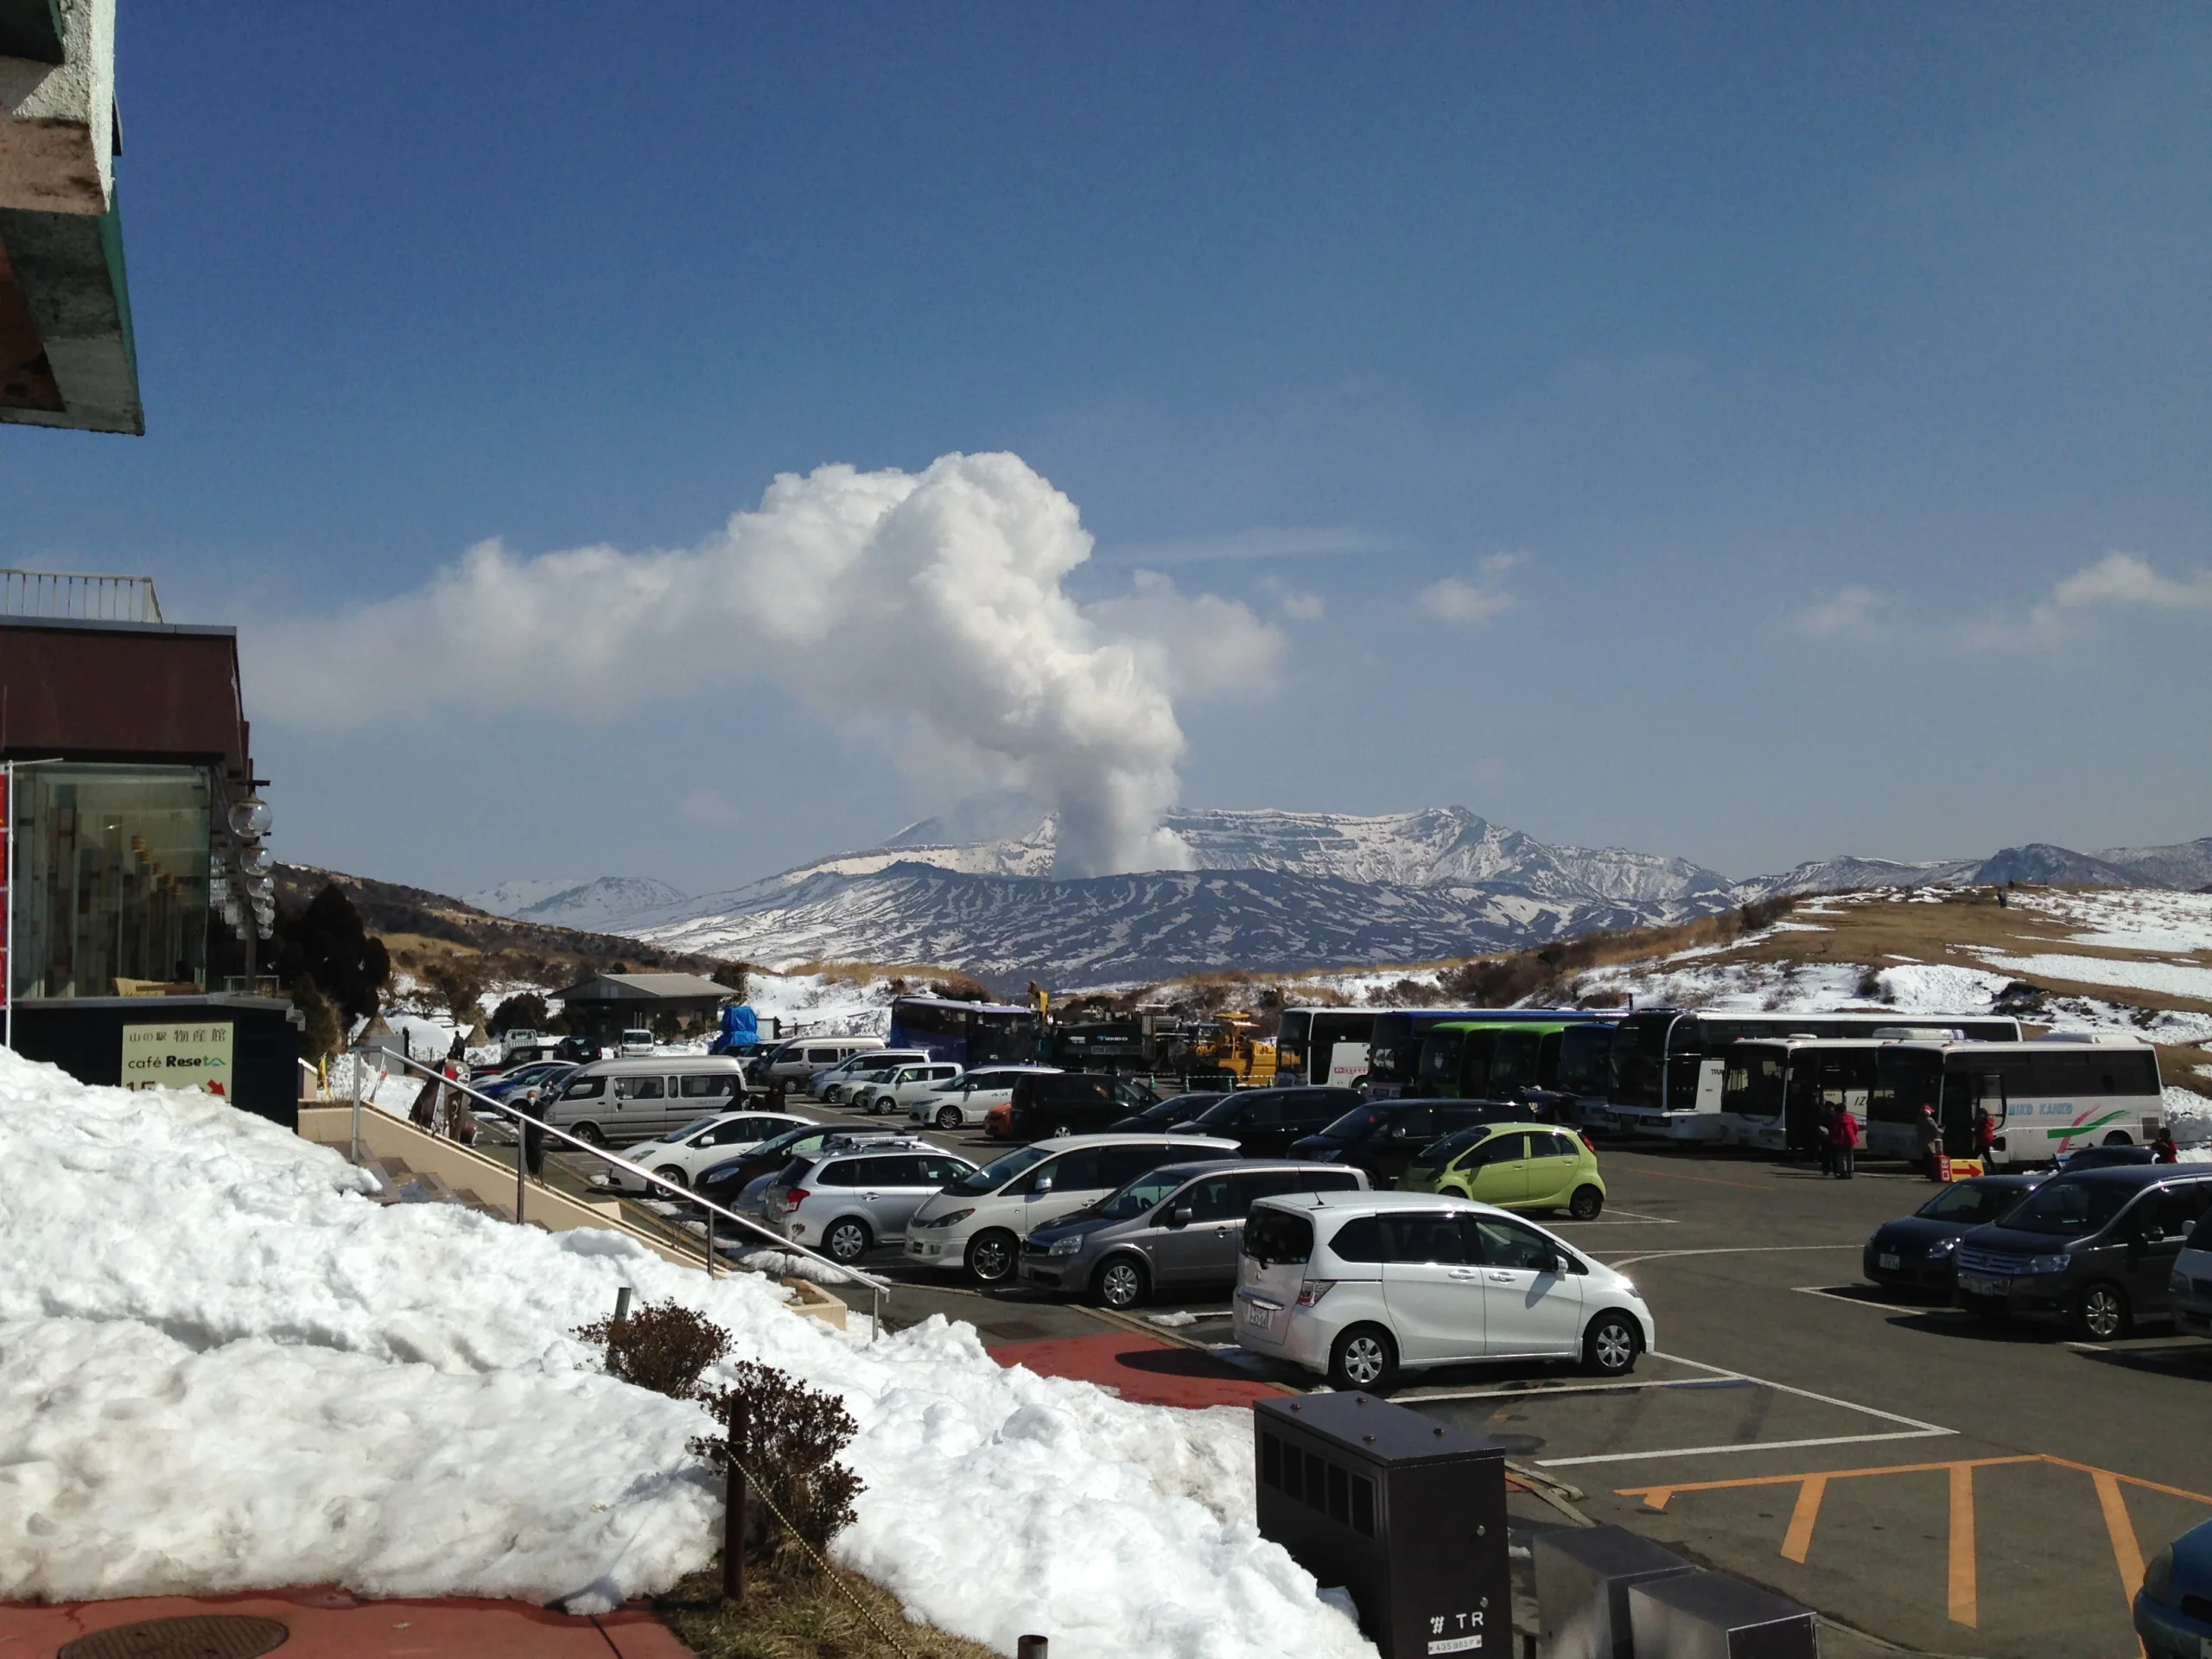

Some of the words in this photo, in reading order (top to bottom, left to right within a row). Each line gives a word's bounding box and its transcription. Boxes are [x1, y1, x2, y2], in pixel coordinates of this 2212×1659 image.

[174, 1028, 226, 1043] 物産館
[128, 1056, 162, 1069] café
[1455, 1611, 1484, 1630] TR
